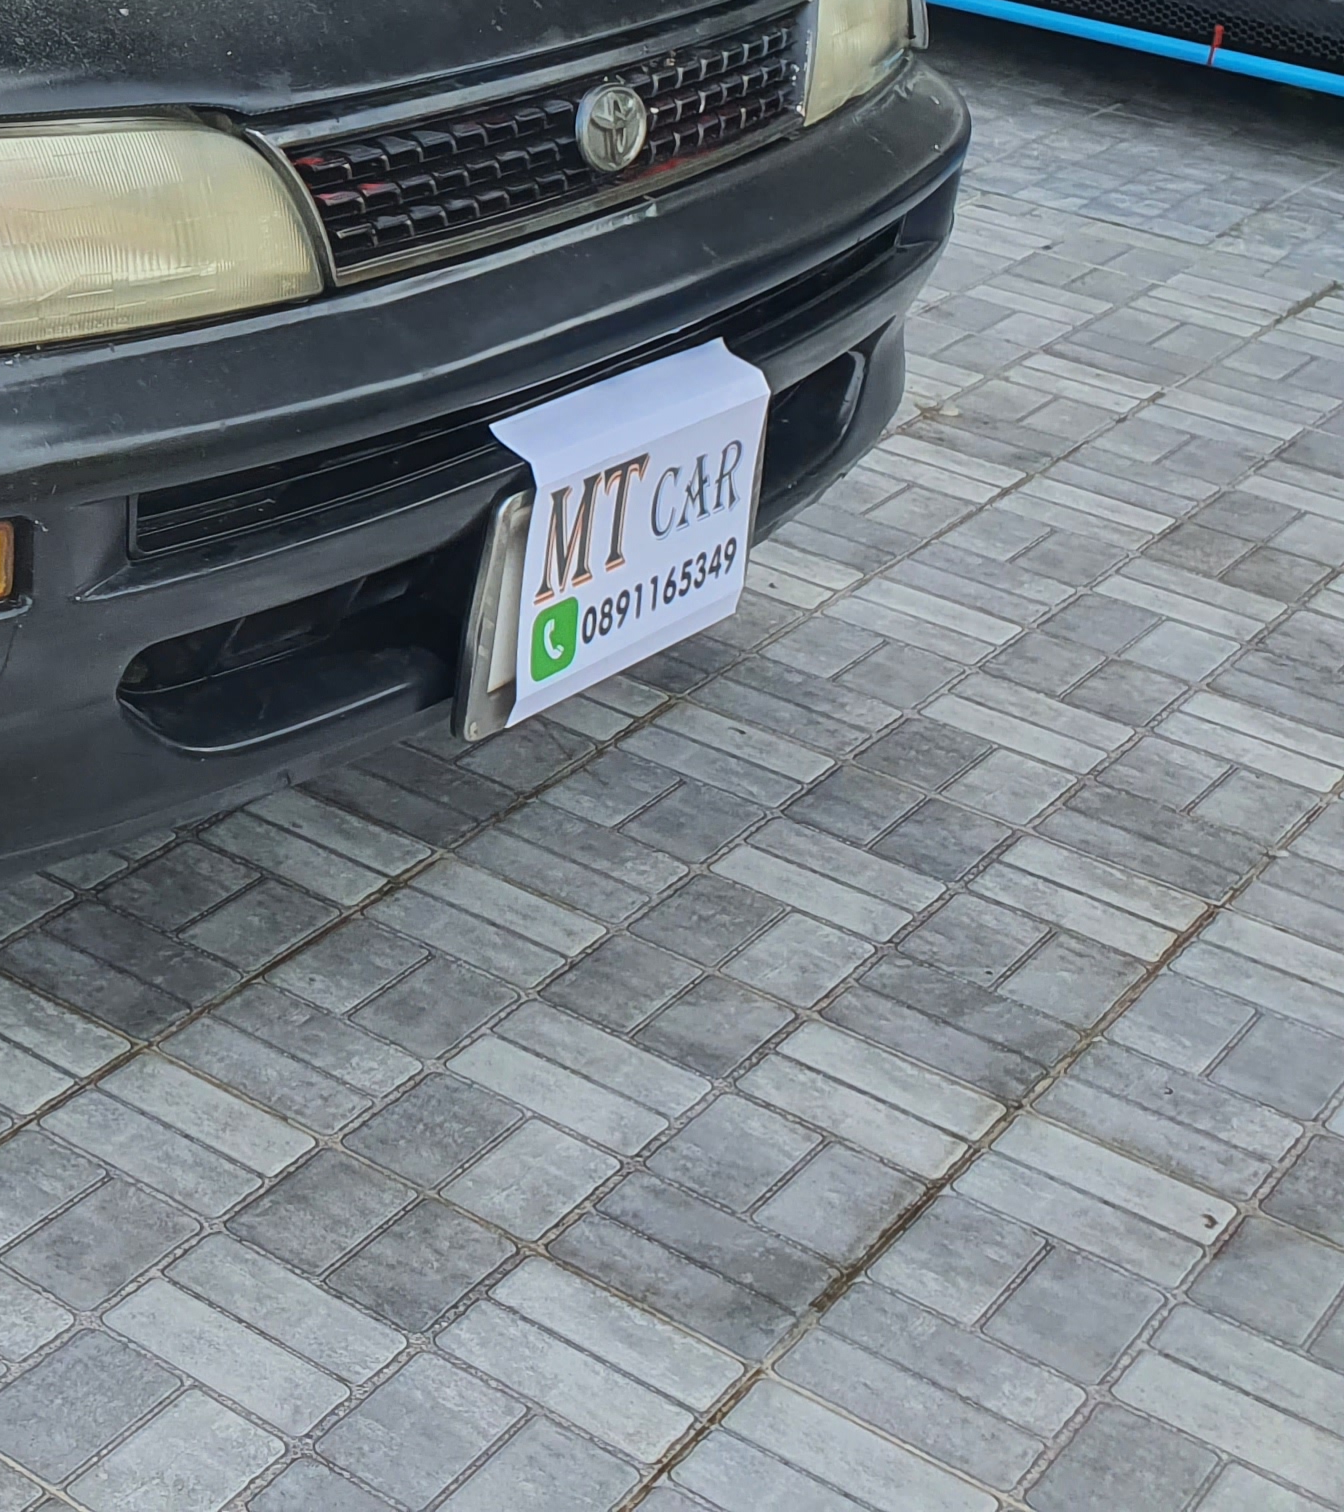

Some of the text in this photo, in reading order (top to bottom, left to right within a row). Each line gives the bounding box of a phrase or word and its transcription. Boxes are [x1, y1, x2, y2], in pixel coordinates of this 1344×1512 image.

[534, 439, 744, 604] MT CAR
[581, 537, 738, 645] 0891165349
